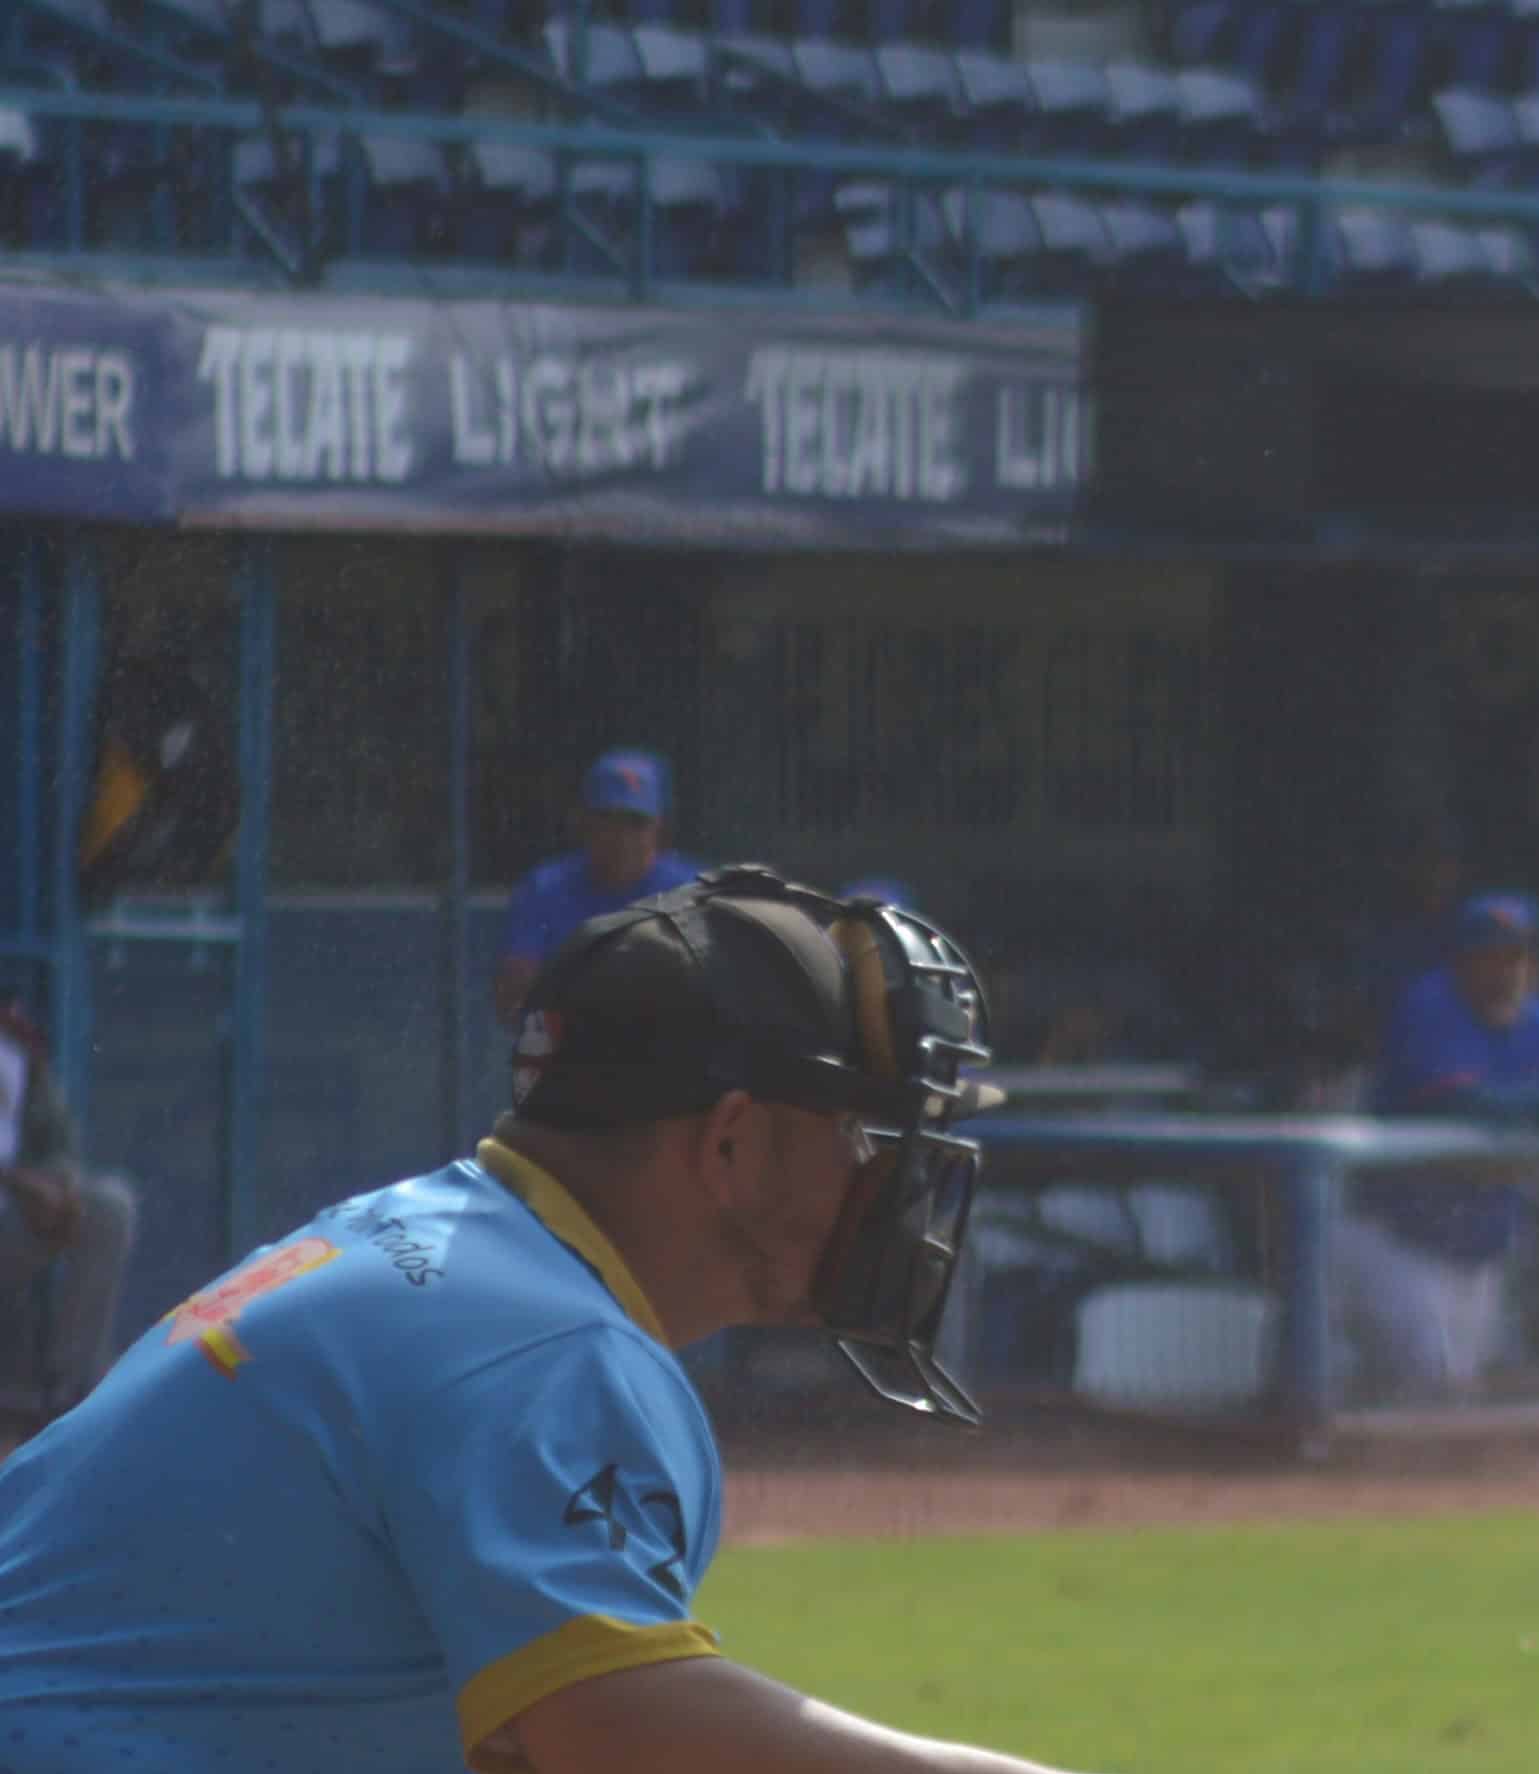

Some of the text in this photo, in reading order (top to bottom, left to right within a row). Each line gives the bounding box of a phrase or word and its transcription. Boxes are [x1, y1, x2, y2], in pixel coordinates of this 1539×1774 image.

[197, 326, 415, 481] TECATE
[447, 352, 692, 473] LIGHT
[742, 348, 968, 500] TECATE
